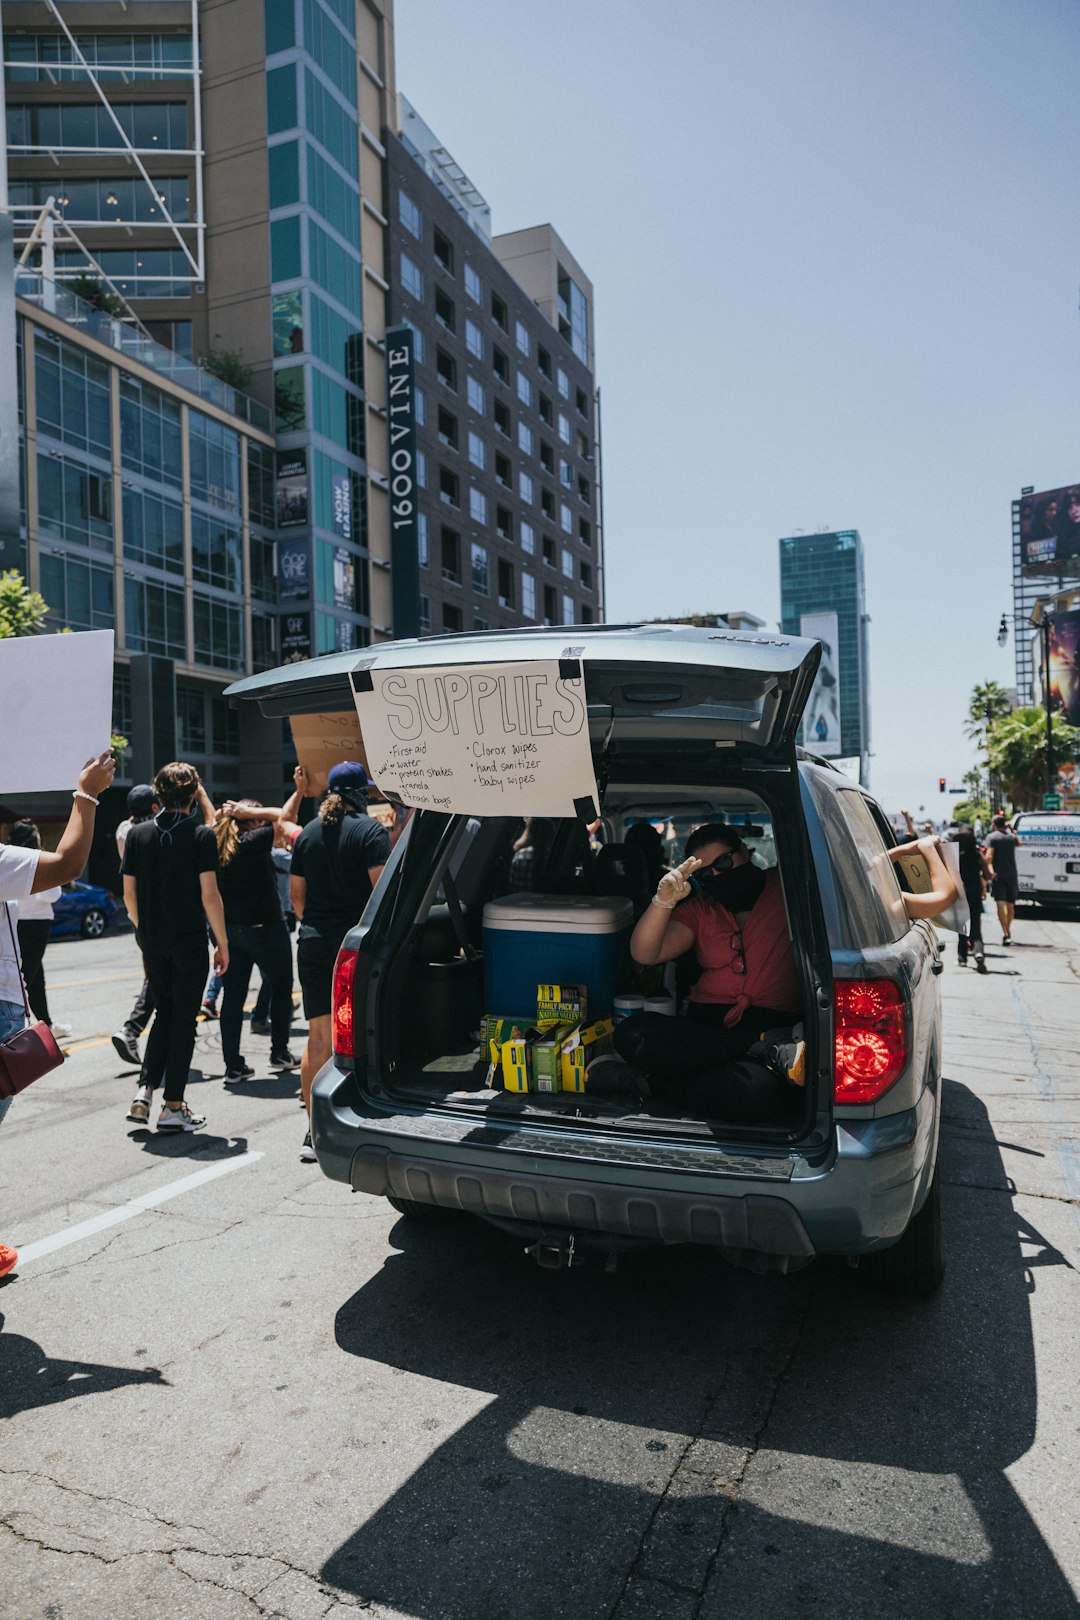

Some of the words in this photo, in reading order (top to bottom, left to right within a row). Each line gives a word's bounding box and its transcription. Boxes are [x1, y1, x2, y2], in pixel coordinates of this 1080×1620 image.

[334, 486, 343, 524] NOW
[342, 480, 351, 538] LEASING
[381, 674, 585, 741] SUPPLIES
[392, 745, 413, 758] First
[415, 742, 427, 754] aid
[472, 742, 506, 757] Clorox
[512, 742, 538, 759] wipes
[396, 759, 421, 769] water
[475, 762, 497, 773] hand
[500, 759, 541, 772] sanitizer
[399, 769, 425, 782] protein
[427, 767, 454, 778] shakes
[401, 782, 430, 793] granola
[479, 776, 504, 791] baby
[507, 774, 535, 789] wipes
[407, 794, 430, 803] trash
[433, 796, 452, 808] bags
[538, 1002, 557, 1010] FAMILY
[558, 1003, 573, 1011] PACK
[538, 1011, 559, 1020] NATURE
[560, 1011, 579, 1020] VALLEY
